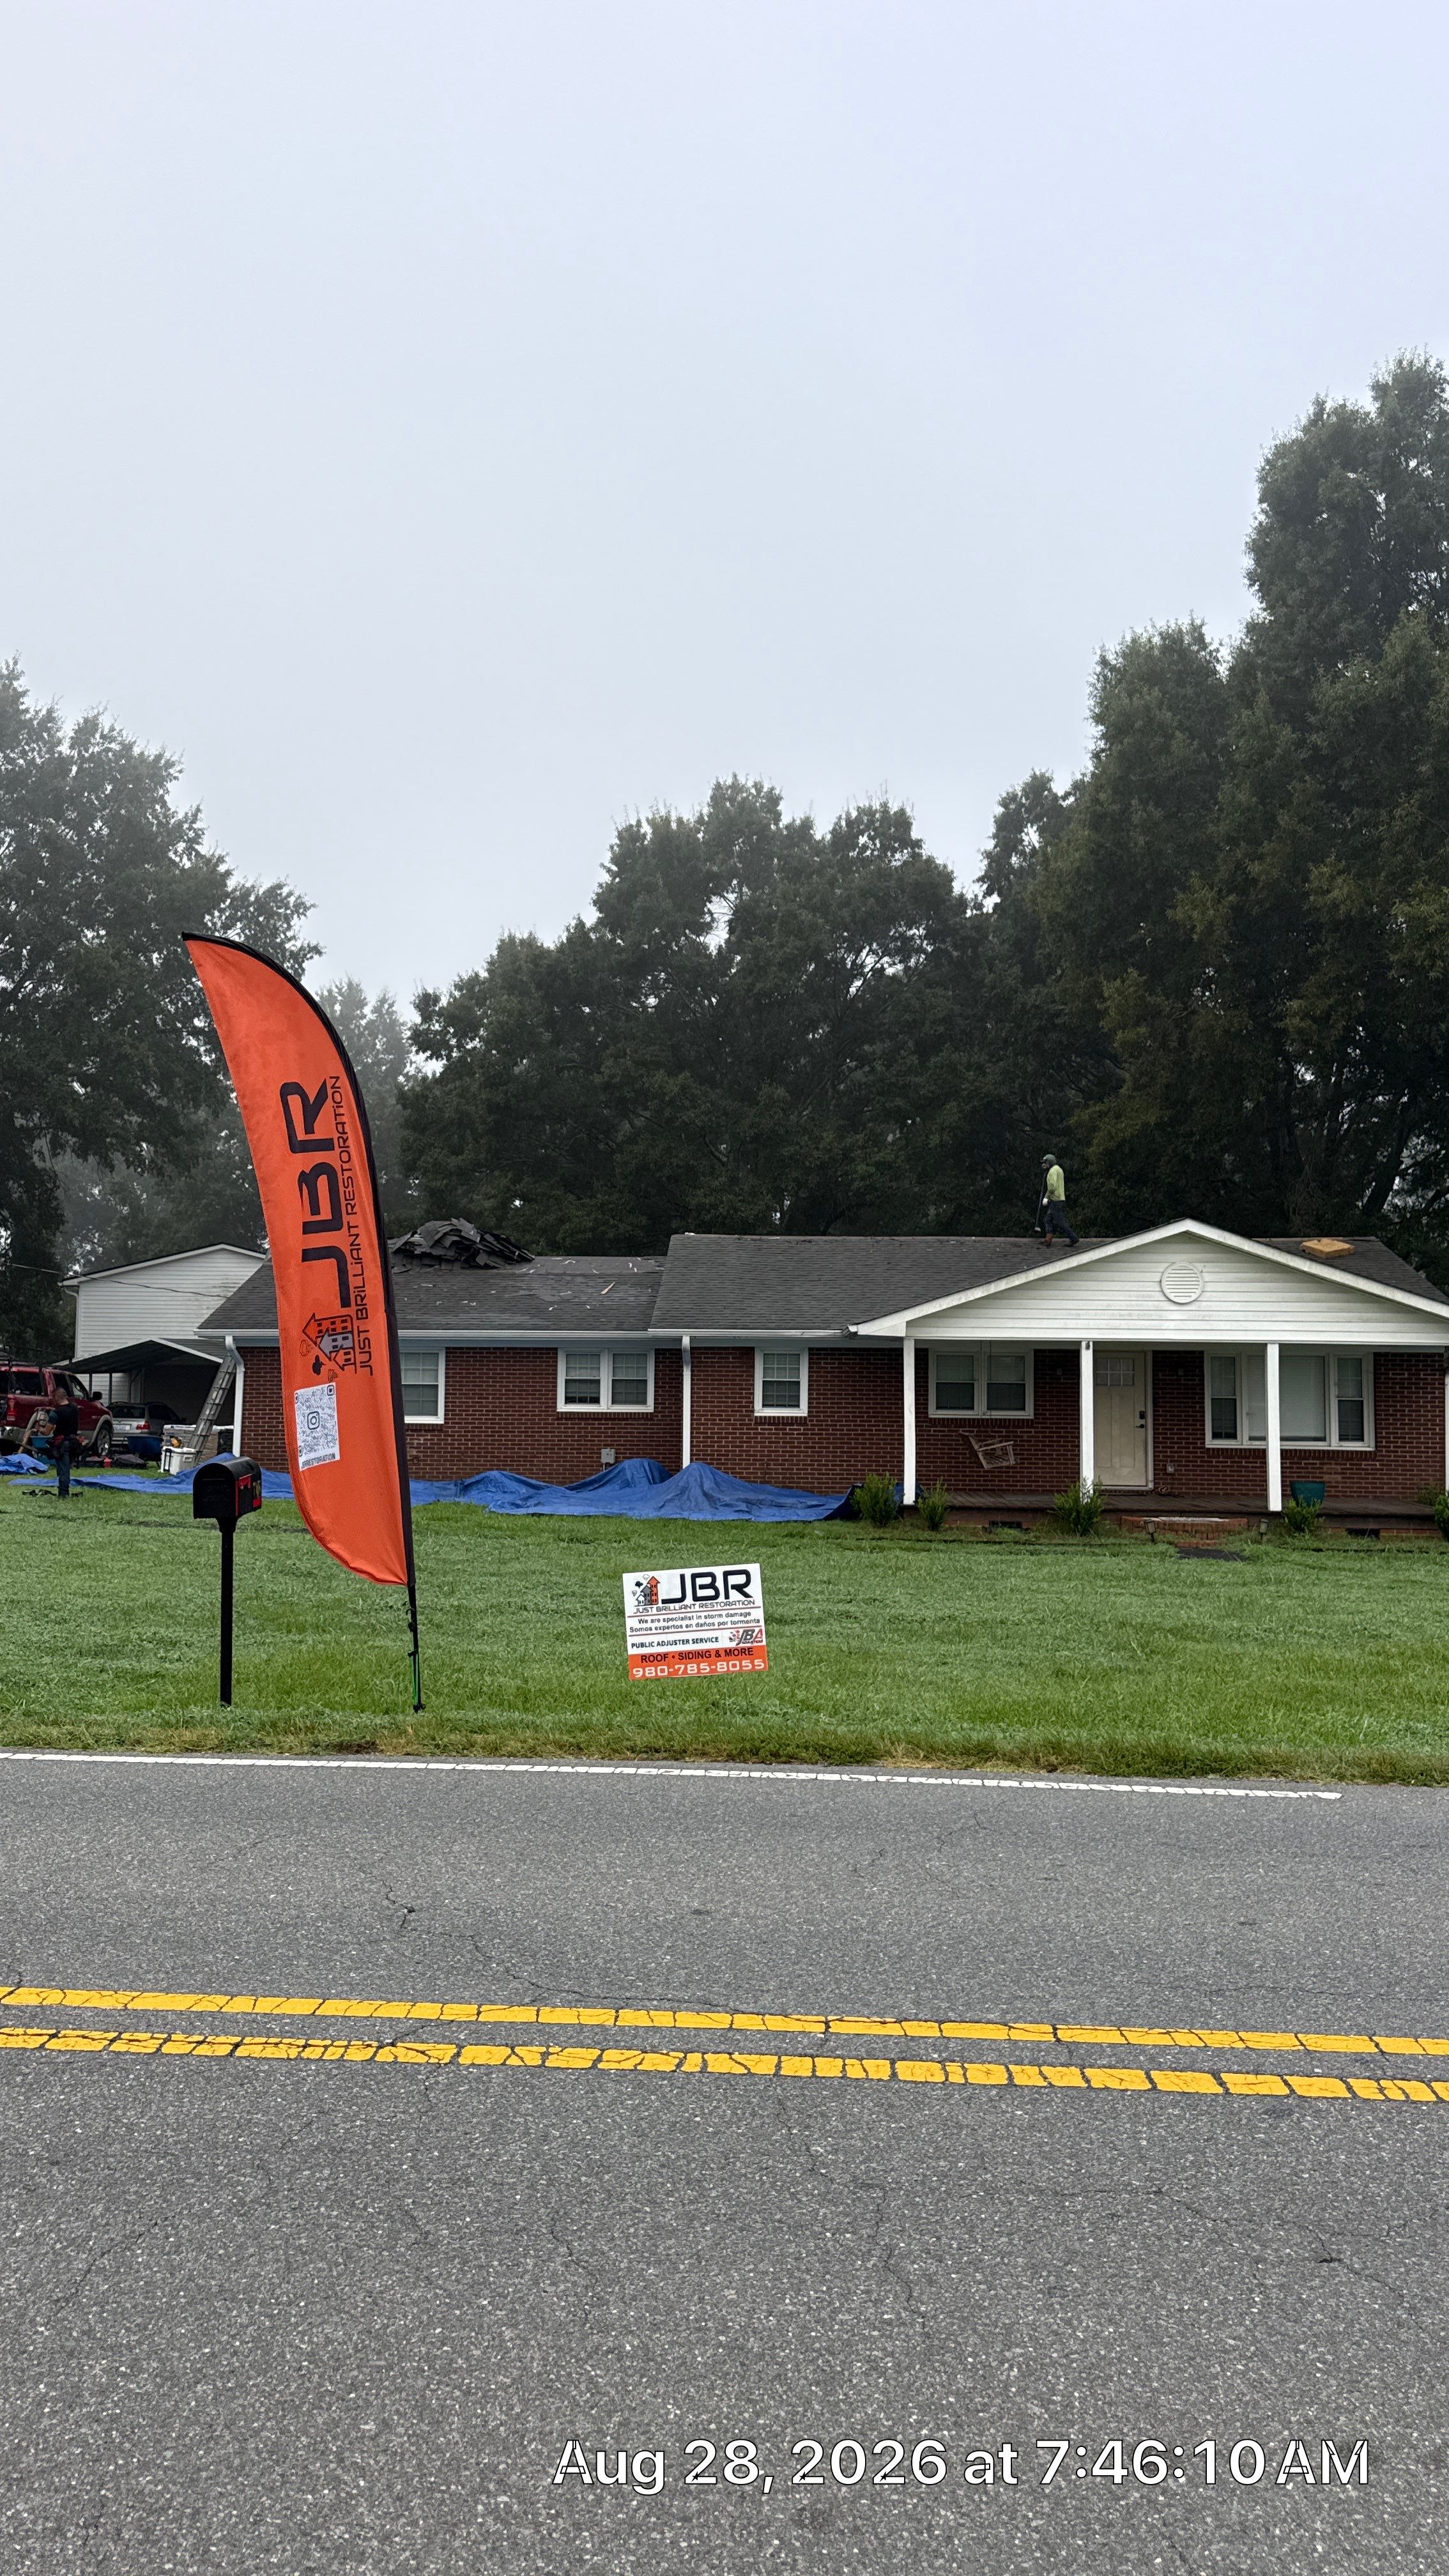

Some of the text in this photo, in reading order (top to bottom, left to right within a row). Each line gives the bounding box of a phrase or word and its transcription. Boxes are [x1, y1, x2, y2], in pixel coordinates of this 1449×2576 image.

[279, 1077, 351, 1308] JBR
[357, 1325, 373, 1376] JUST
[661, 1568, 753, 1604] JBR
[633, 1606, 654, 1614] JUST
[663, 1614, 694, 1623] specialist
[654, 1623, 684, 1632] expertos
[631, 1636, 719, 1649] PUBLIC ADJUSTER SERVICE
[735, 1628, 763, 1646] JBA
[640, 1647, 755, 1664] ROOF SIDING & MORE
[632, 1659, 765, 1678] 980-785-8055
